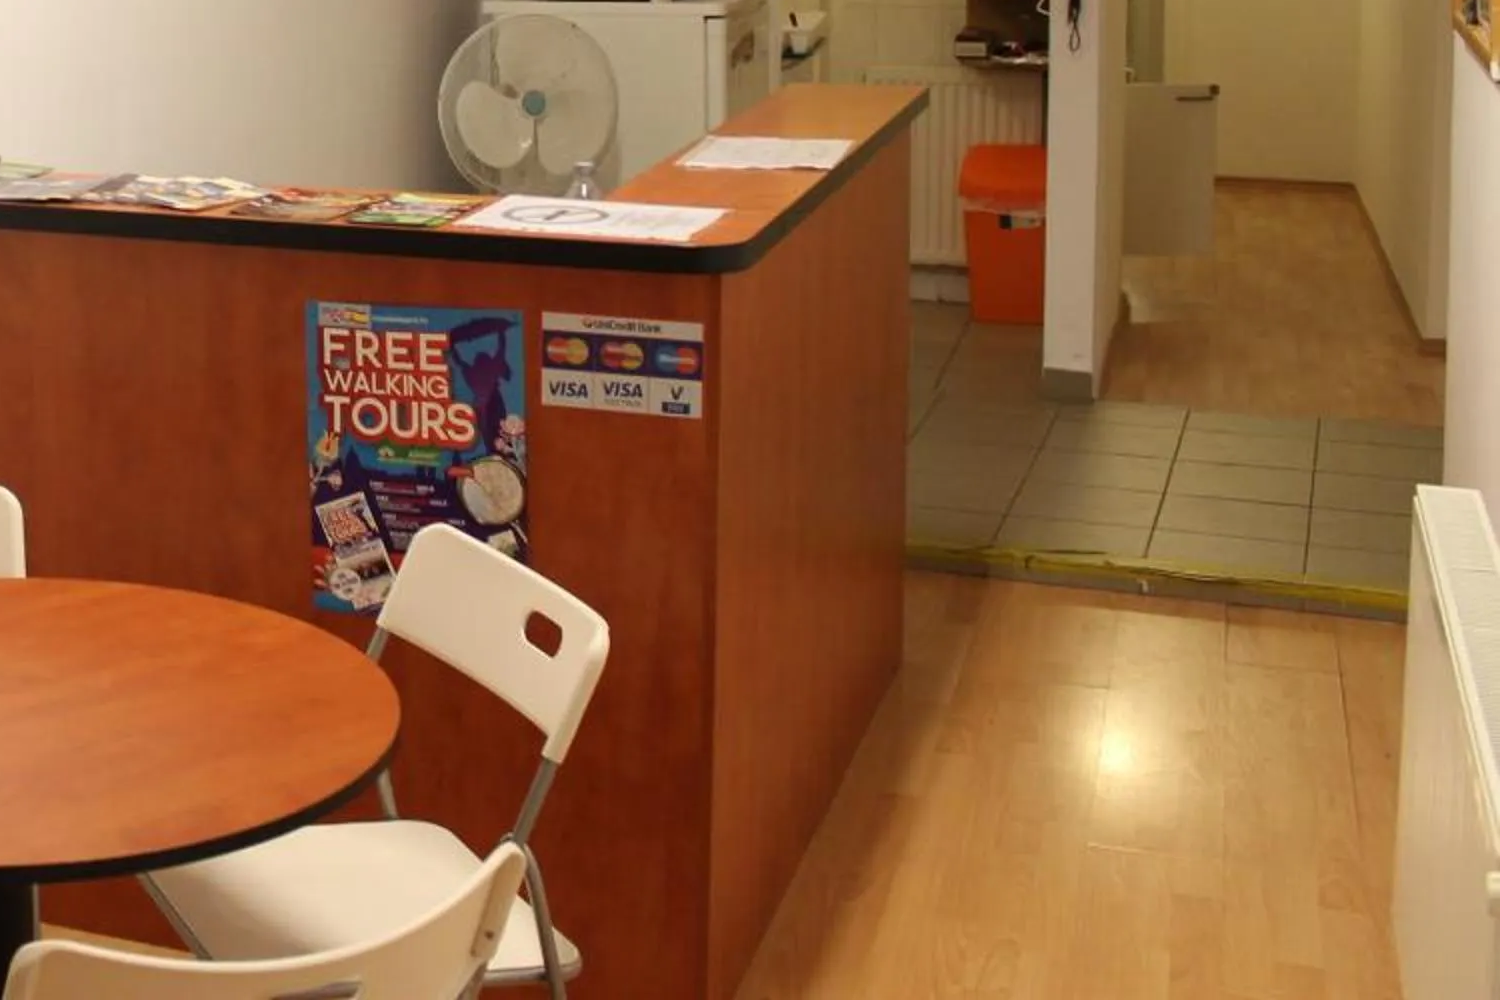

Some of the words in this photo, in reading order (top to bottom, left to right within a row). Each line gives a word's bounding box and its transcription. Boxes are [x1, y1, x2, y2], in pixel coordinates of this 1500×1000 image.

[323, 326, 449, 373] FREE
[323, 367, 450, 400] WALKING
[549, 381, 589, 399] VISA
[603, 381, 644, 398] VISA
[670, 385, 684, 401] V
[323, 395, 477, 443] TOURS
